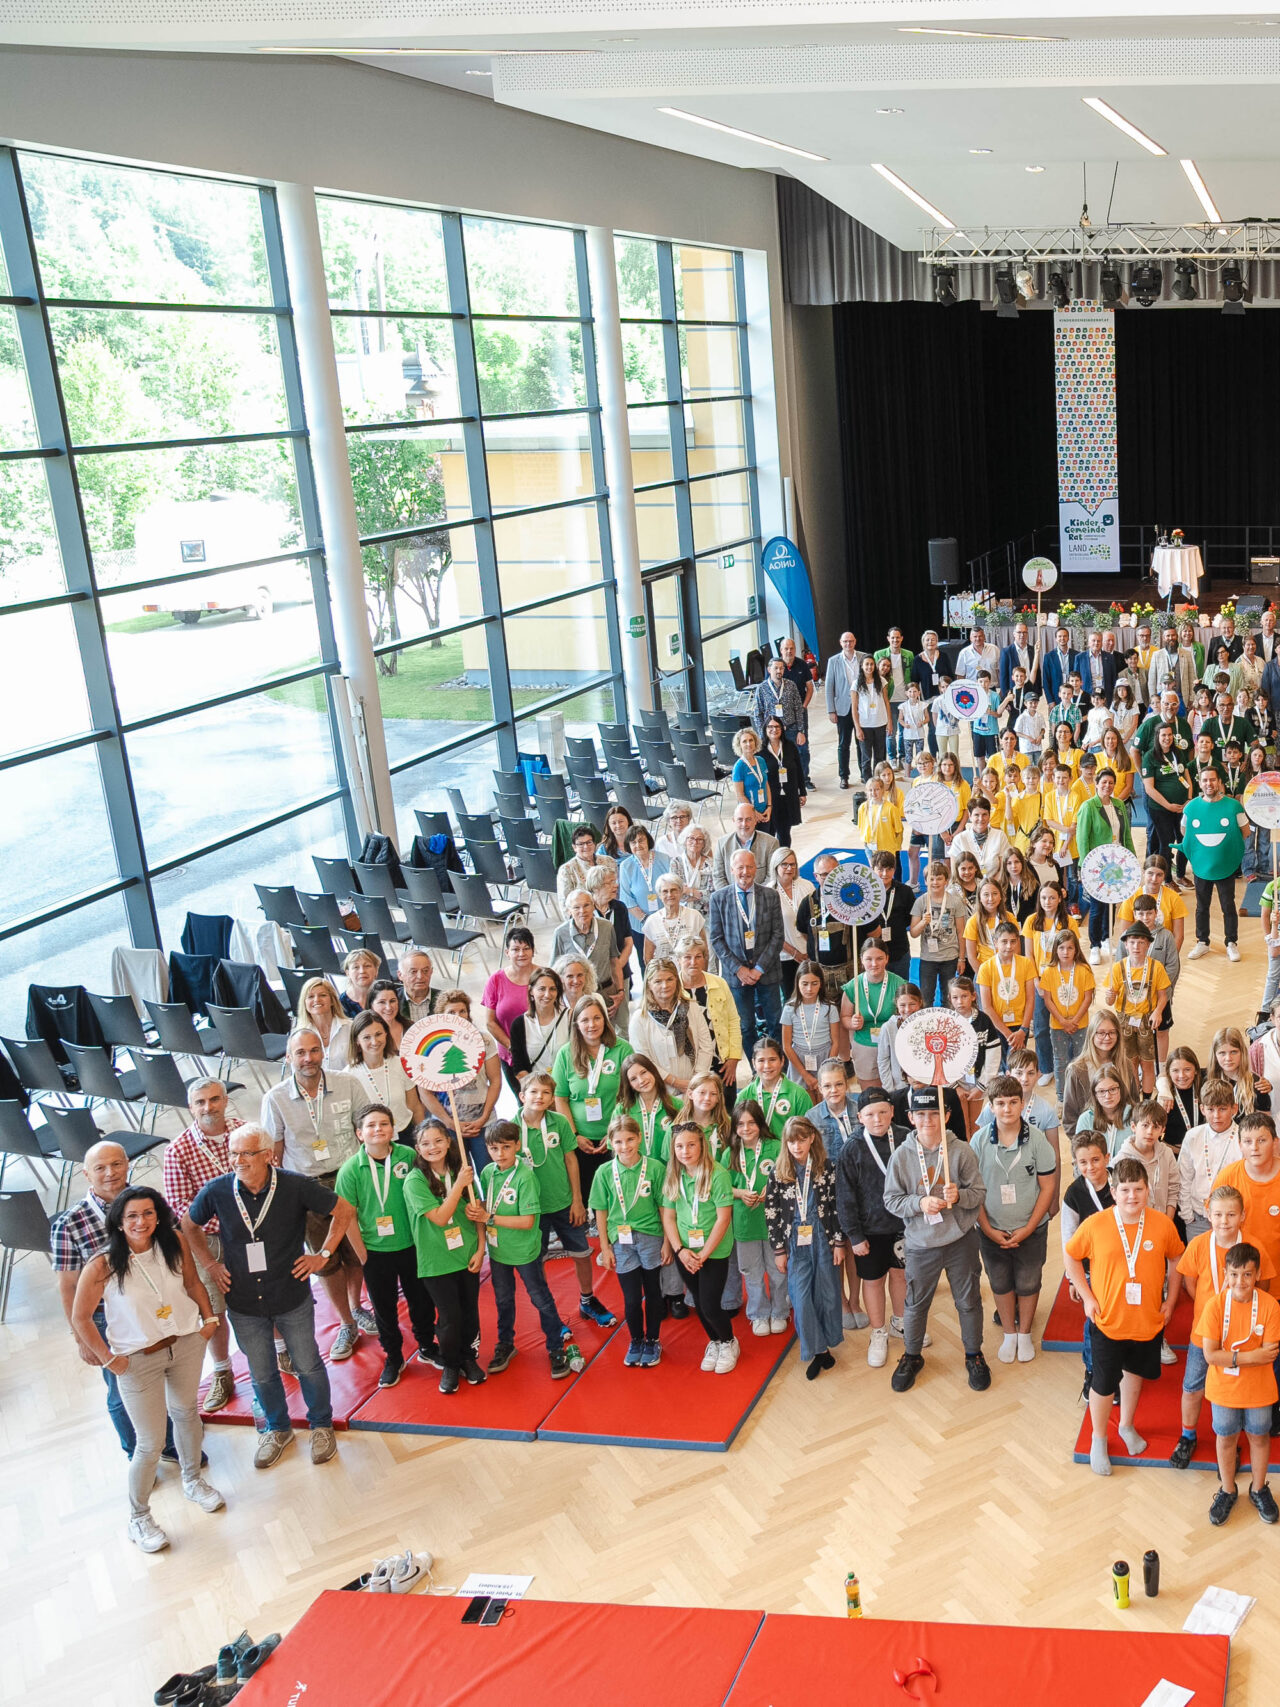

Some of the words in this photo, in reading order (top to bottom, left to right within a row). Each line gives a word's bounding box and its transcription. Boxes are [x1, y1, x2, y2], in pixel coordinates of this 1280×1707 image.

[1070, 518, 1099, 527] Kinder
[1064, 526, 1106, 534] Gemeinde
[1068, 544, 1087, 552] LAND
[824, 865, 846, 896] KINDER
[852, 864, 882, 913] GEMEINDE
[401, 1014, 484, 1057] KINDERGEMEINDERAT
